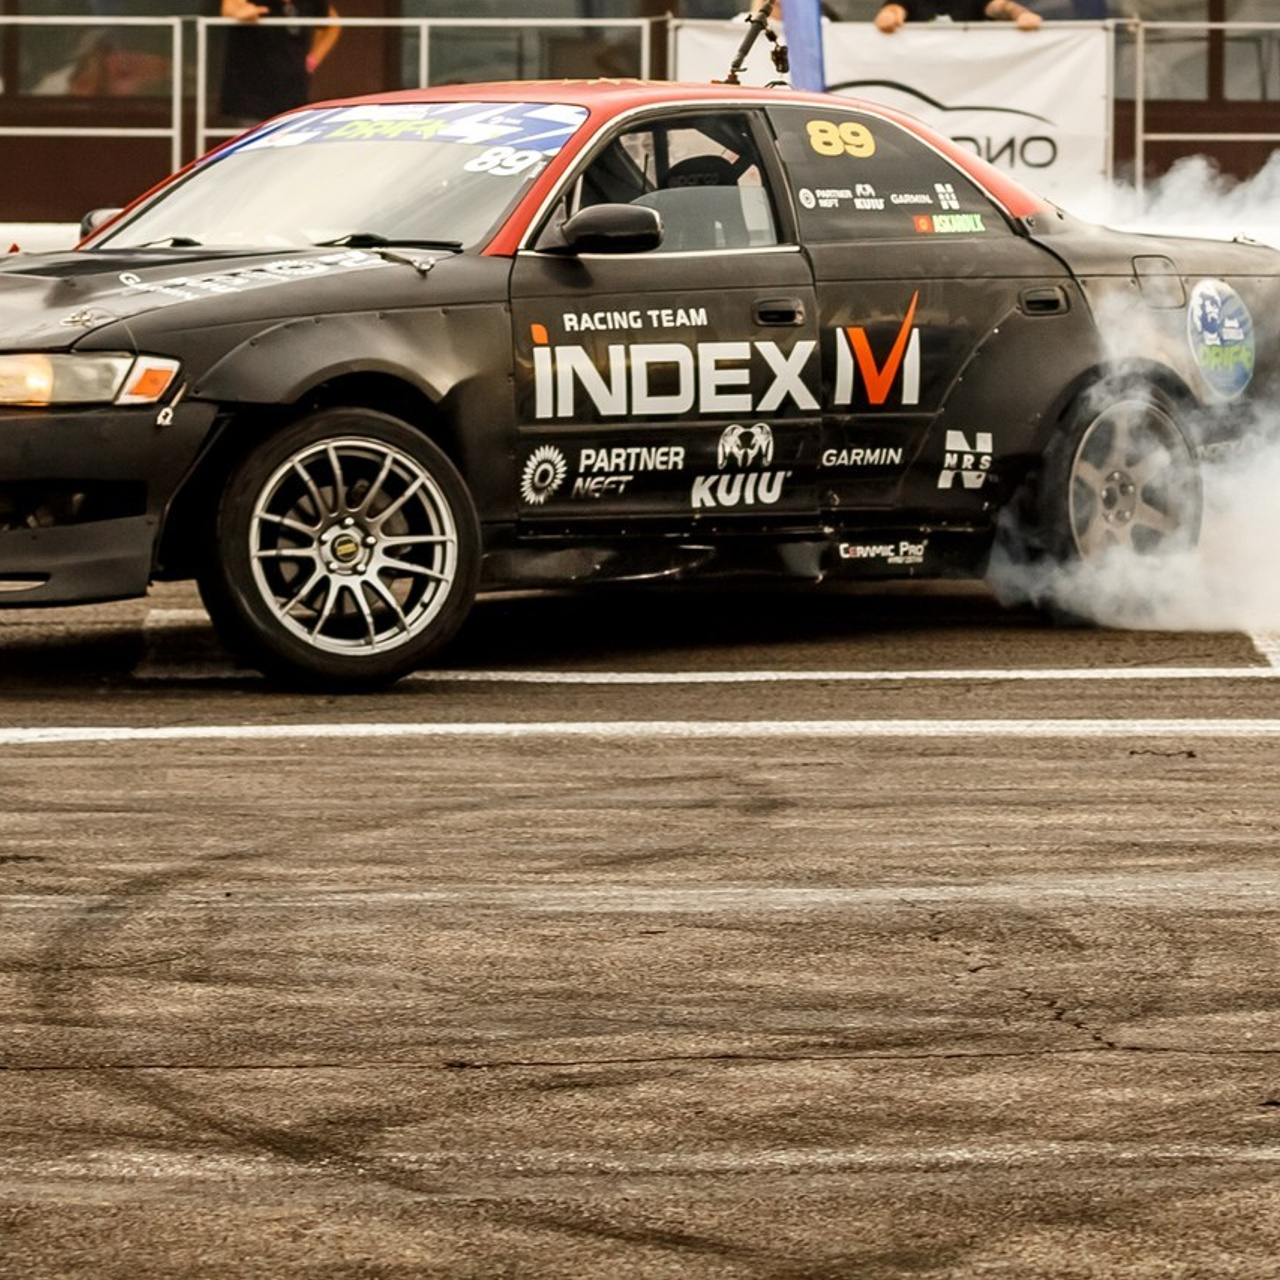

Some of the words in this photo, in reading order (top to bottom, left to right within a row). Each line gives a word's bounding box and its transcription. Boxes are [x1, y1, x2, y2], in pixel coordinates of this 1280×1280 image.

[806, 120, 876, 158] 89
[464, 146, 544, 176] 89
[854, 198, 885, 210] KUIU
[563, 311, 640, 332] RACING
[647, 308, 708, 328] TEAM
[578, 447, 685, 472] PARTNER
[822, 448, 903, 467] GARMIN
[691, 472, 786, 508] KUIU
